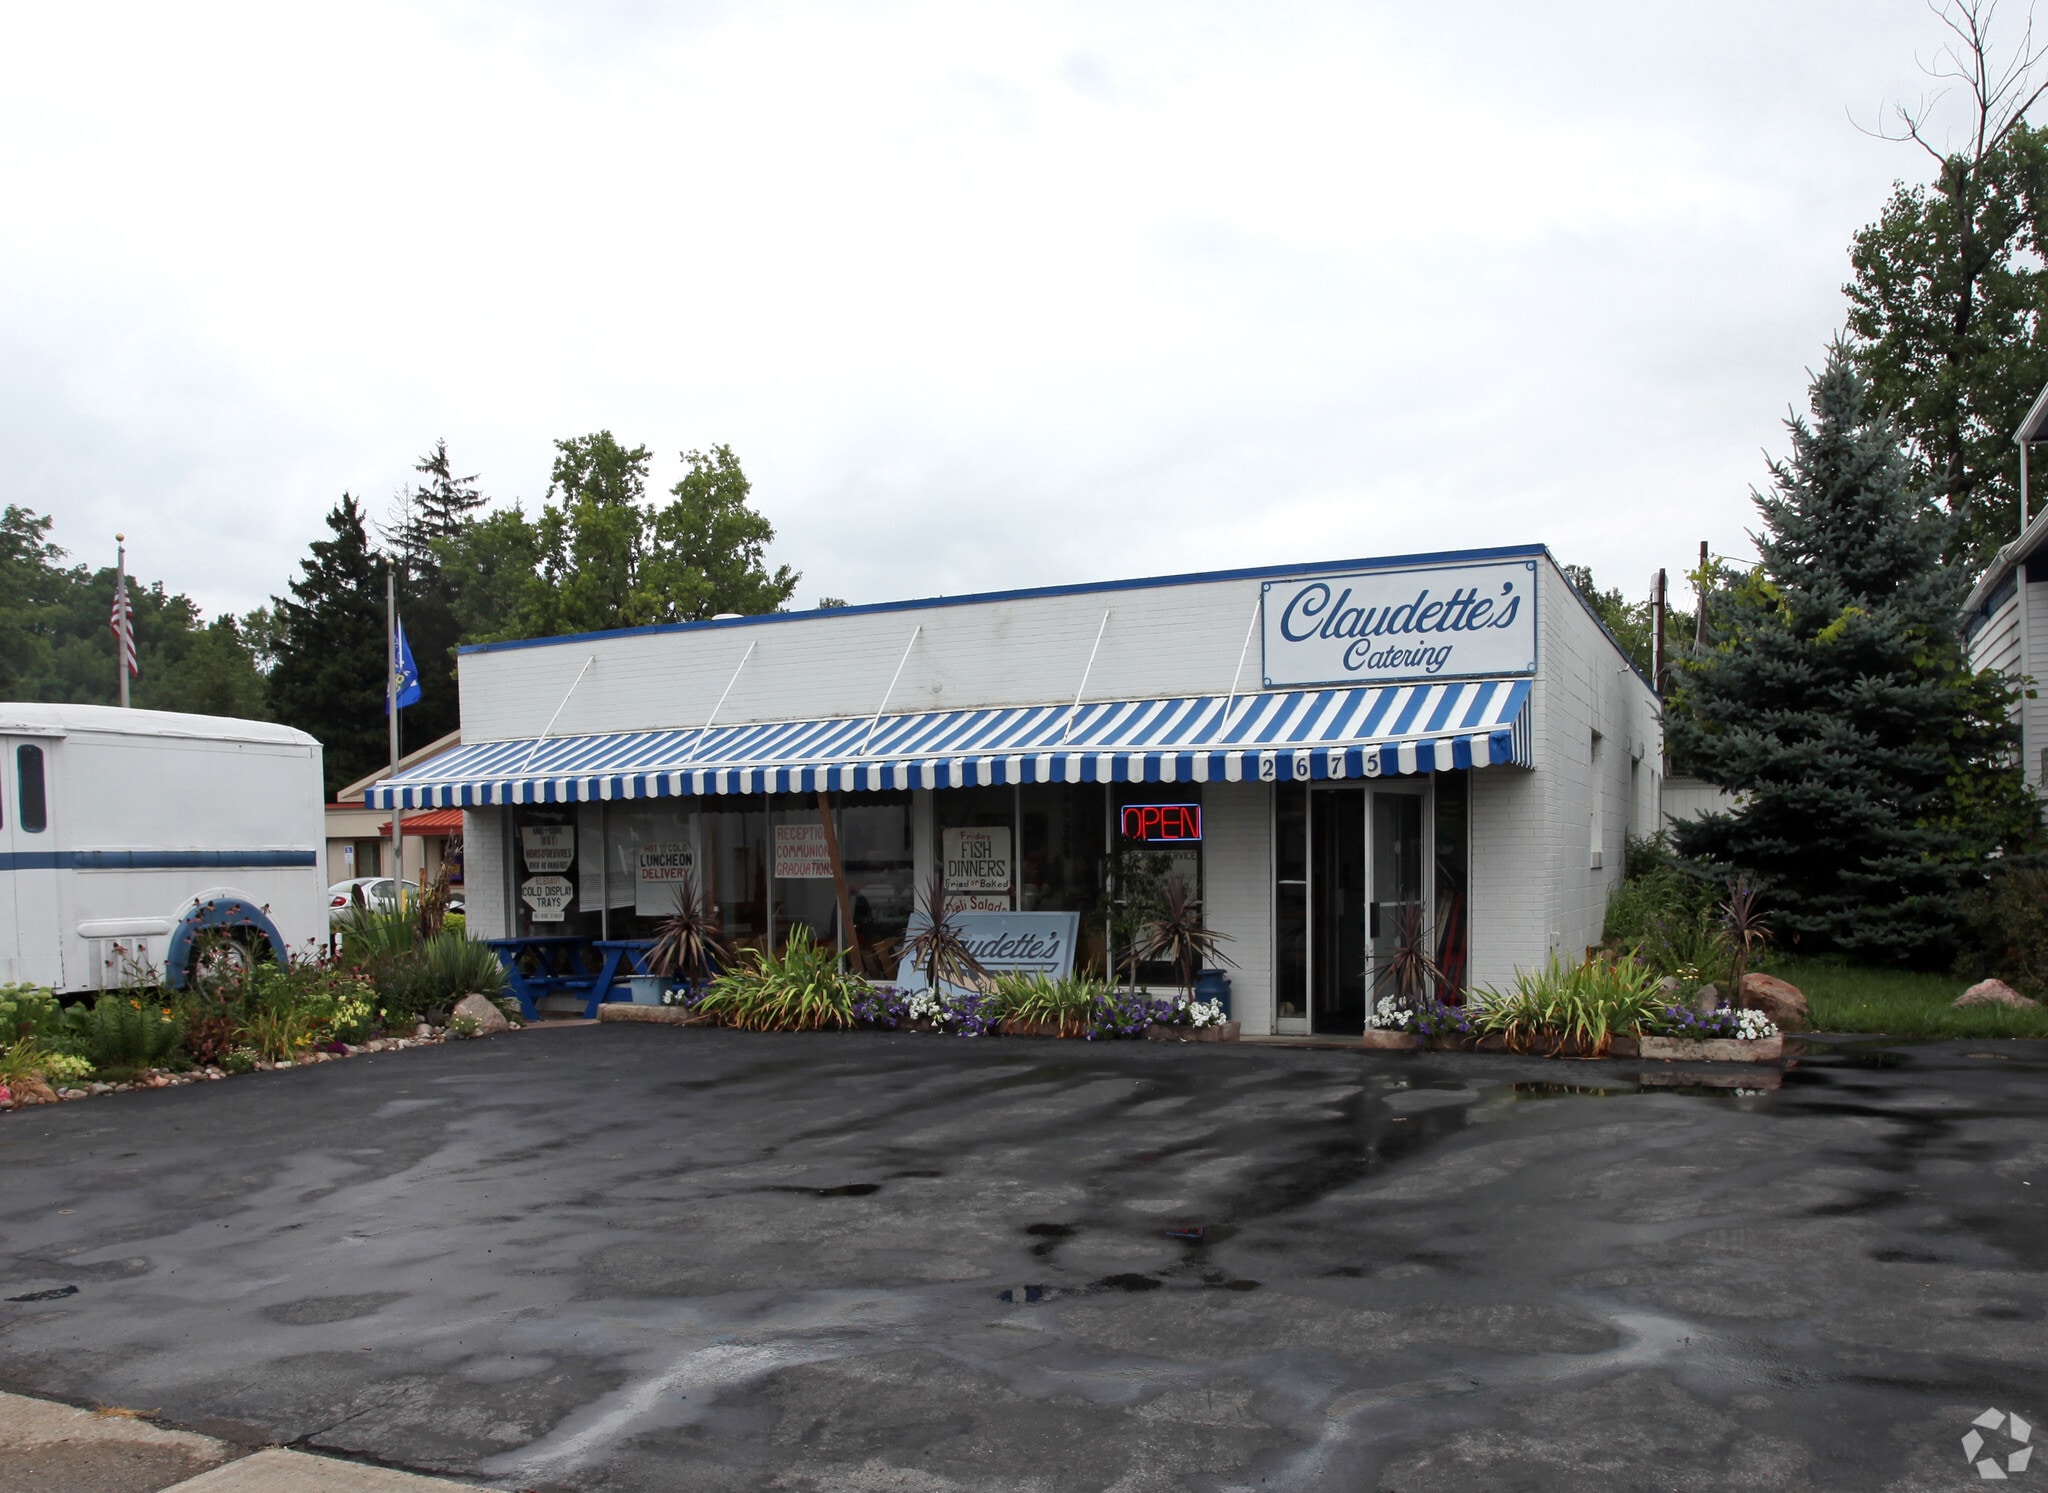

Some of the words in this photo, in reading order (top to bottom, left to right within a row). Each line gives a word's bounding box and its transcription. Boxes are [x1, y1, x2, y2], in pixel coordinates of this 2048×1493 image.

[1280, 581, 1521, 642] Claudette's
[1343, 638, 1453, 673] Catering
[1123, 806, 1199, 839] OPEN
[777, 827, 824, 841] RECEPTIO
[961, 831, 991, 840] Friday
[644, 844, 657, 852] HOT
[668, 843, 688, 852] COLD
[961, 841, 992, 858] FISH
[640, 853, 693, 867] LUNCHEON
[642, 867, 690, 879] DELIVERY
[948, 860, 1005, 877] DINNERS
[522, 886, 542, 896] COLD
[545, 886, 572, 896] DISPLAY
[537, 897, 561, 907] TRAYS
[916, 923, 1061, 959] audette's
